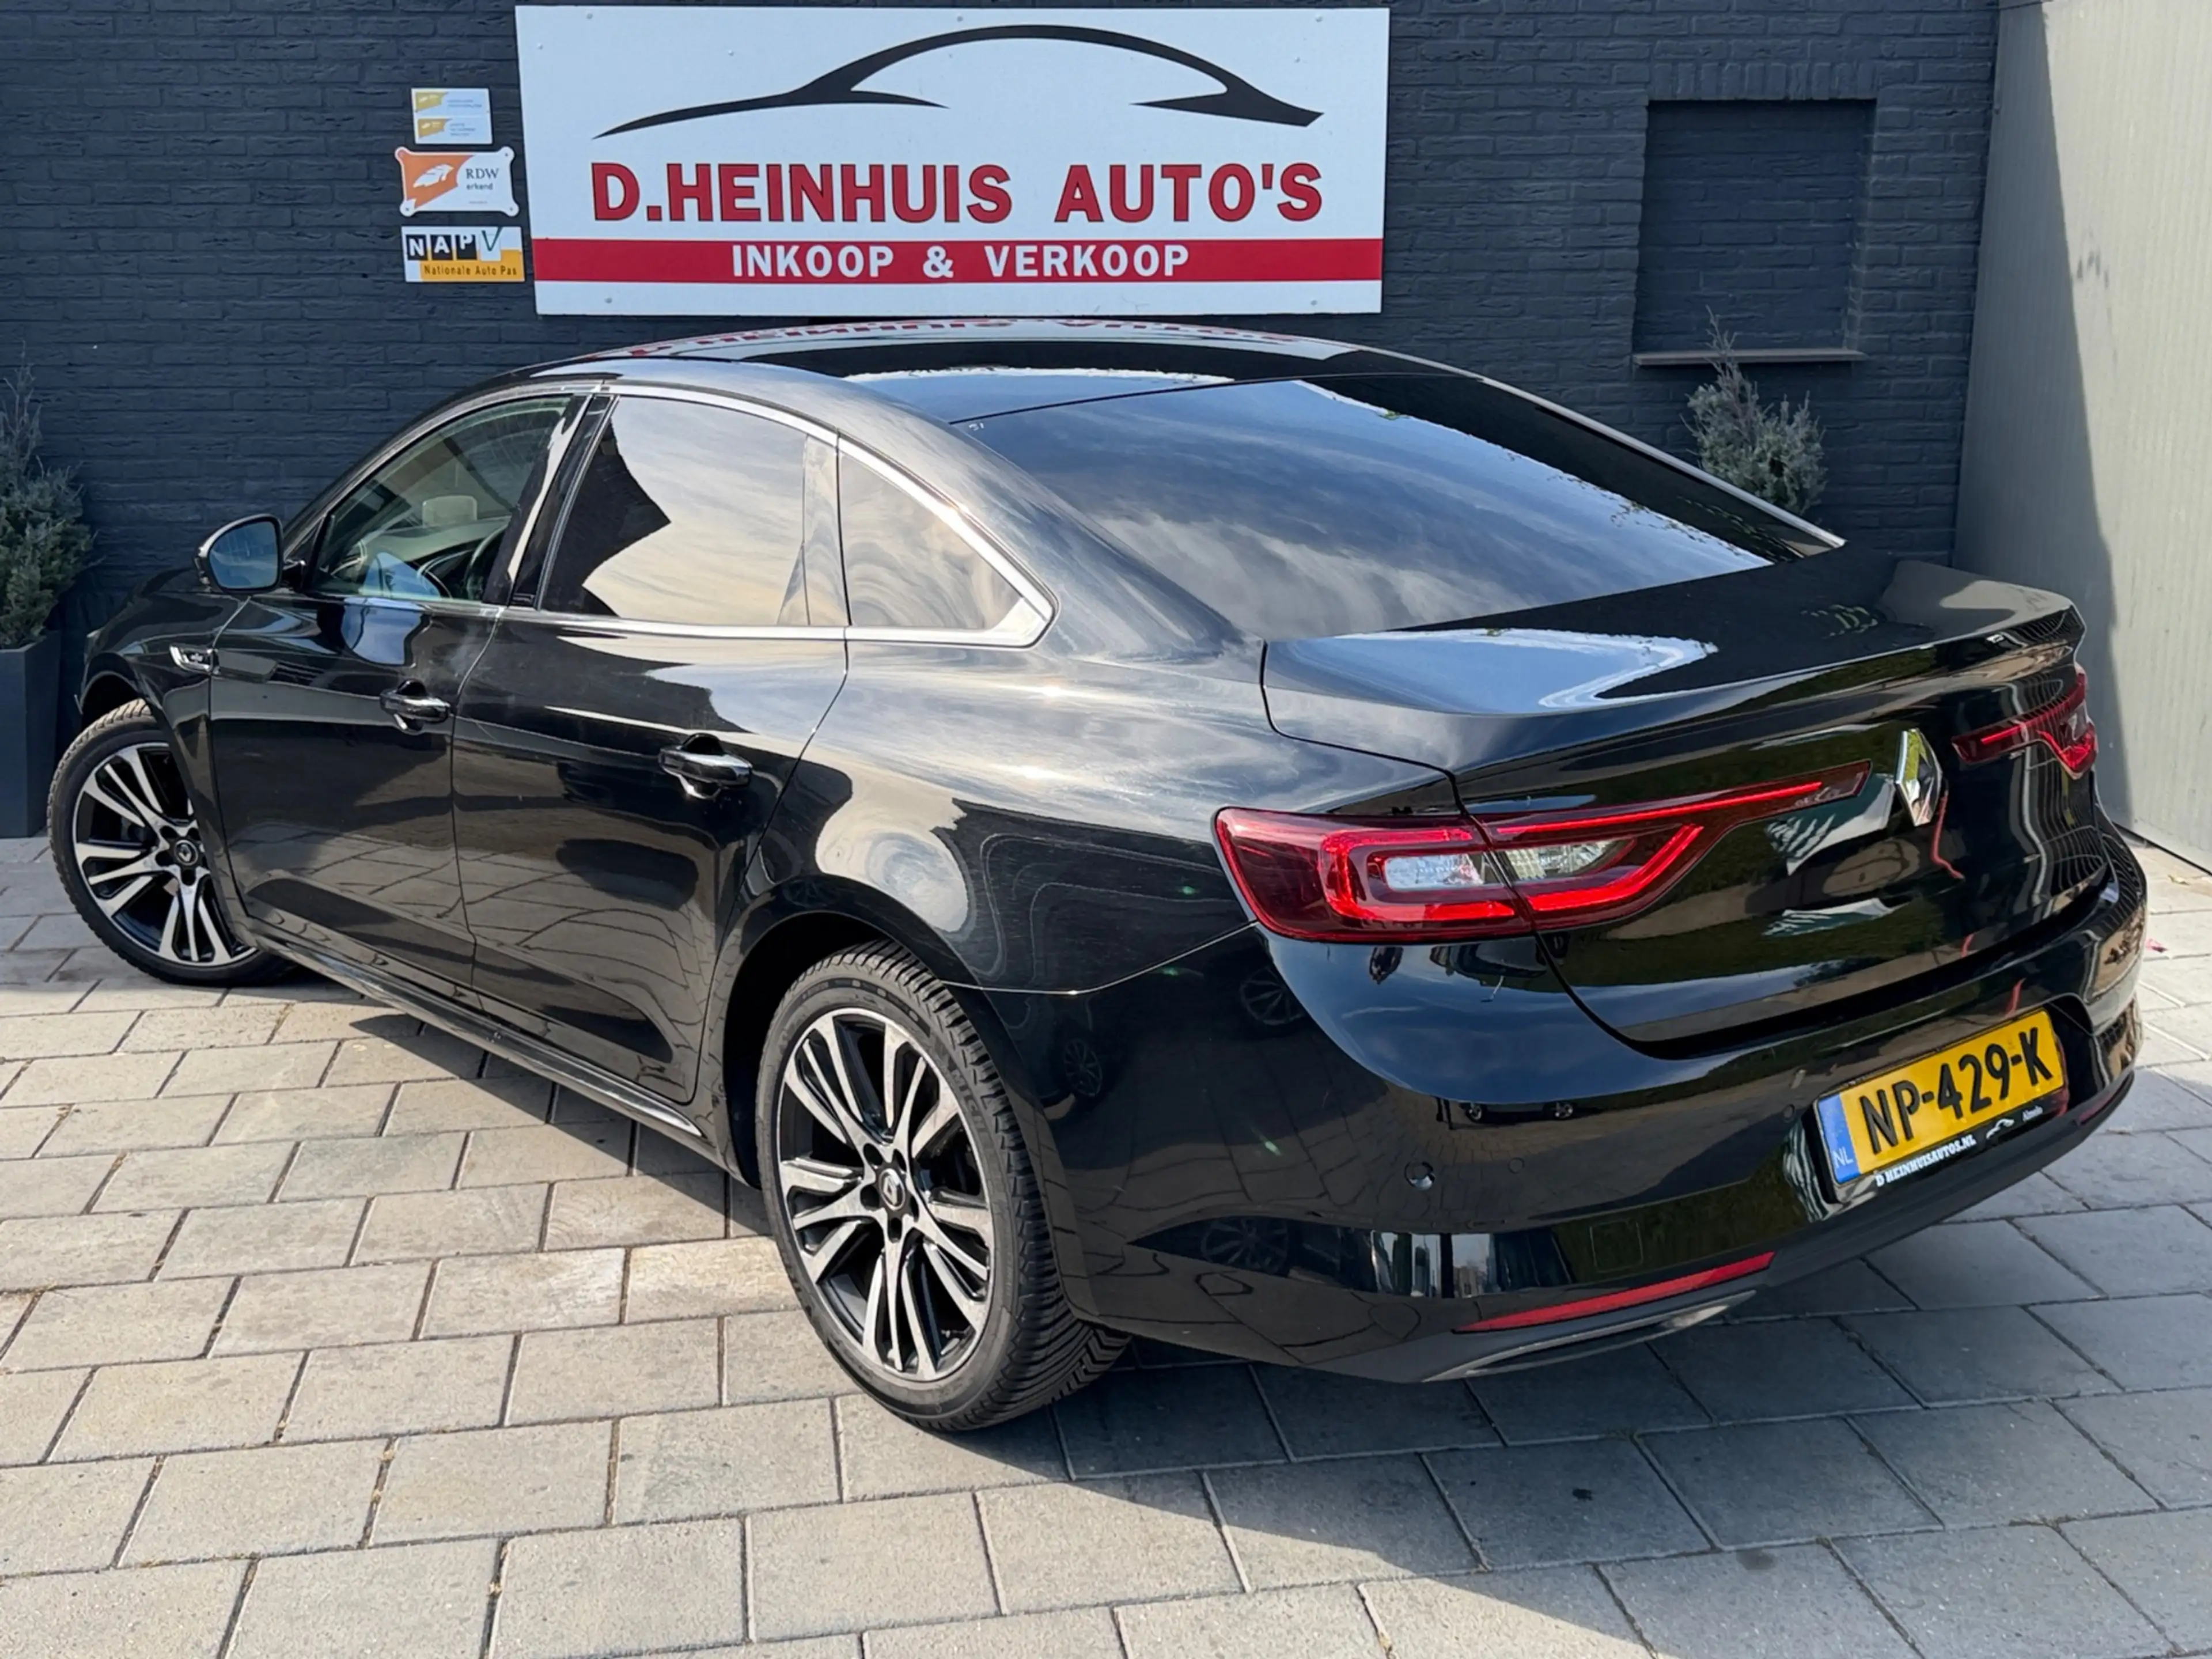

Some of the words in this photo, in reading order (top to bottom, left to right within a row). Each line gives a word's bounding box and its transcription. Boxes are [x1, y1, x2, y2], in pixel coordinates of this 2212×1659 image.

[465, 168, 499, 179] RDW
[591, 162, 1012, 224] D.HEINHUIS
[1054, 162, 1322, 223] AUTO'S
[424, 265, 471, 276] Nationale
[475, 265, 496, 275] Auto
[500, 265, 517, 276] Pas
[733, 245, 894, 278] INKOOP
[922, 245, 955, 278] &
[984, 244, 1189, 277] VERKOOP
[1859, 1027, 2053, 1155] NP-429-K
[1832, 1146, 1854, 1169] NL
